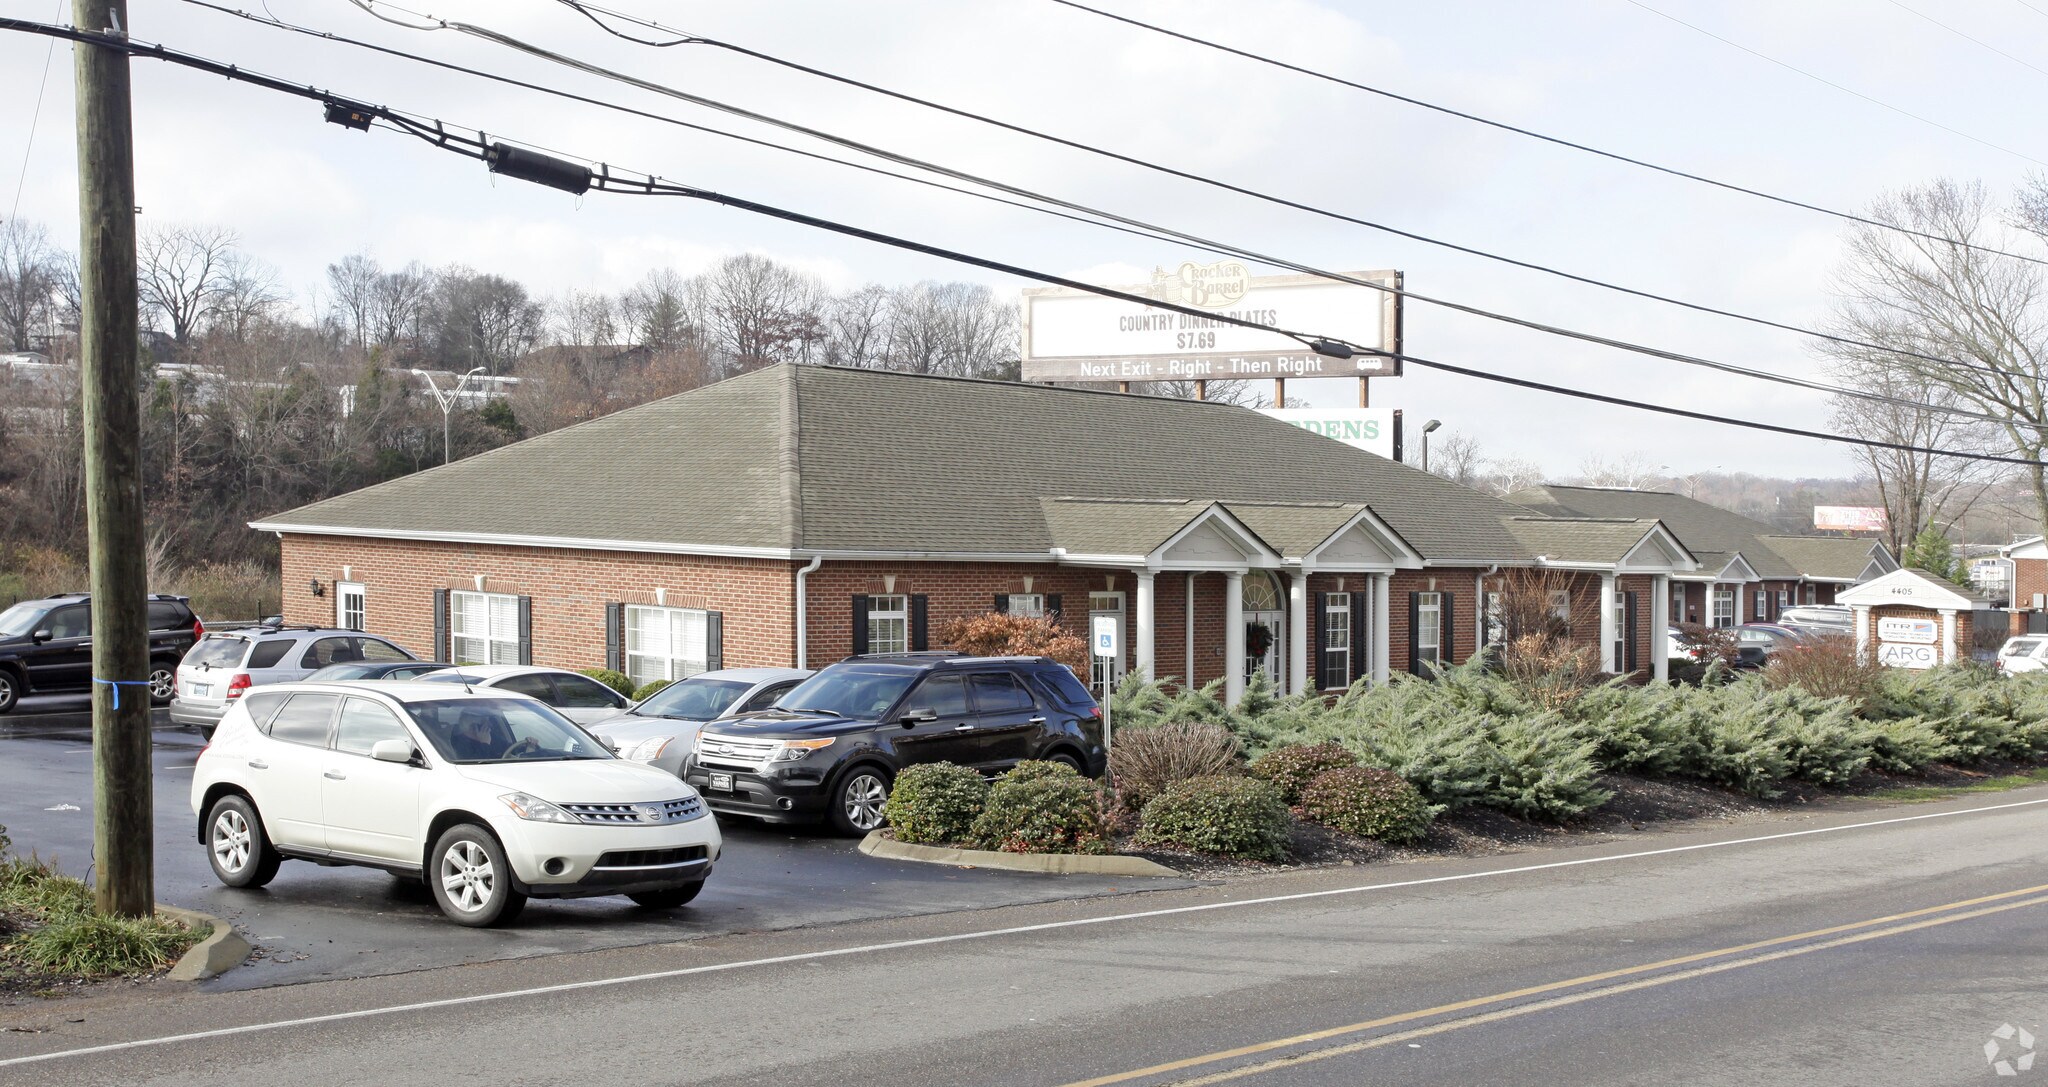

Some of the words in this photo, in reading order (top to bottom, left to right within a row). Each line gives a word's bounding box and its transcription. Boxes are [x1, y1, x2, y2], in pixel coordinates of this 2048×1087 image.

[1119, 313, 1174, 332] COUNTRY
[1179, 311, 1225, 330] DINNER
[1177, 331, 1216, 349] $7.69
[1080, 361, 1116, 377] Next
[1121, 360, 1151, 377] Exit
[1169, 359, 1211, 378] Right
[1229, 357, 1271, 374] Then
[1277, 356, 1323, 376] Right
[1286, 419, 1380, 440] DENS
[1891, 587, 1913, 596] 4405
[1885, 646, 1930, 661] ARG
